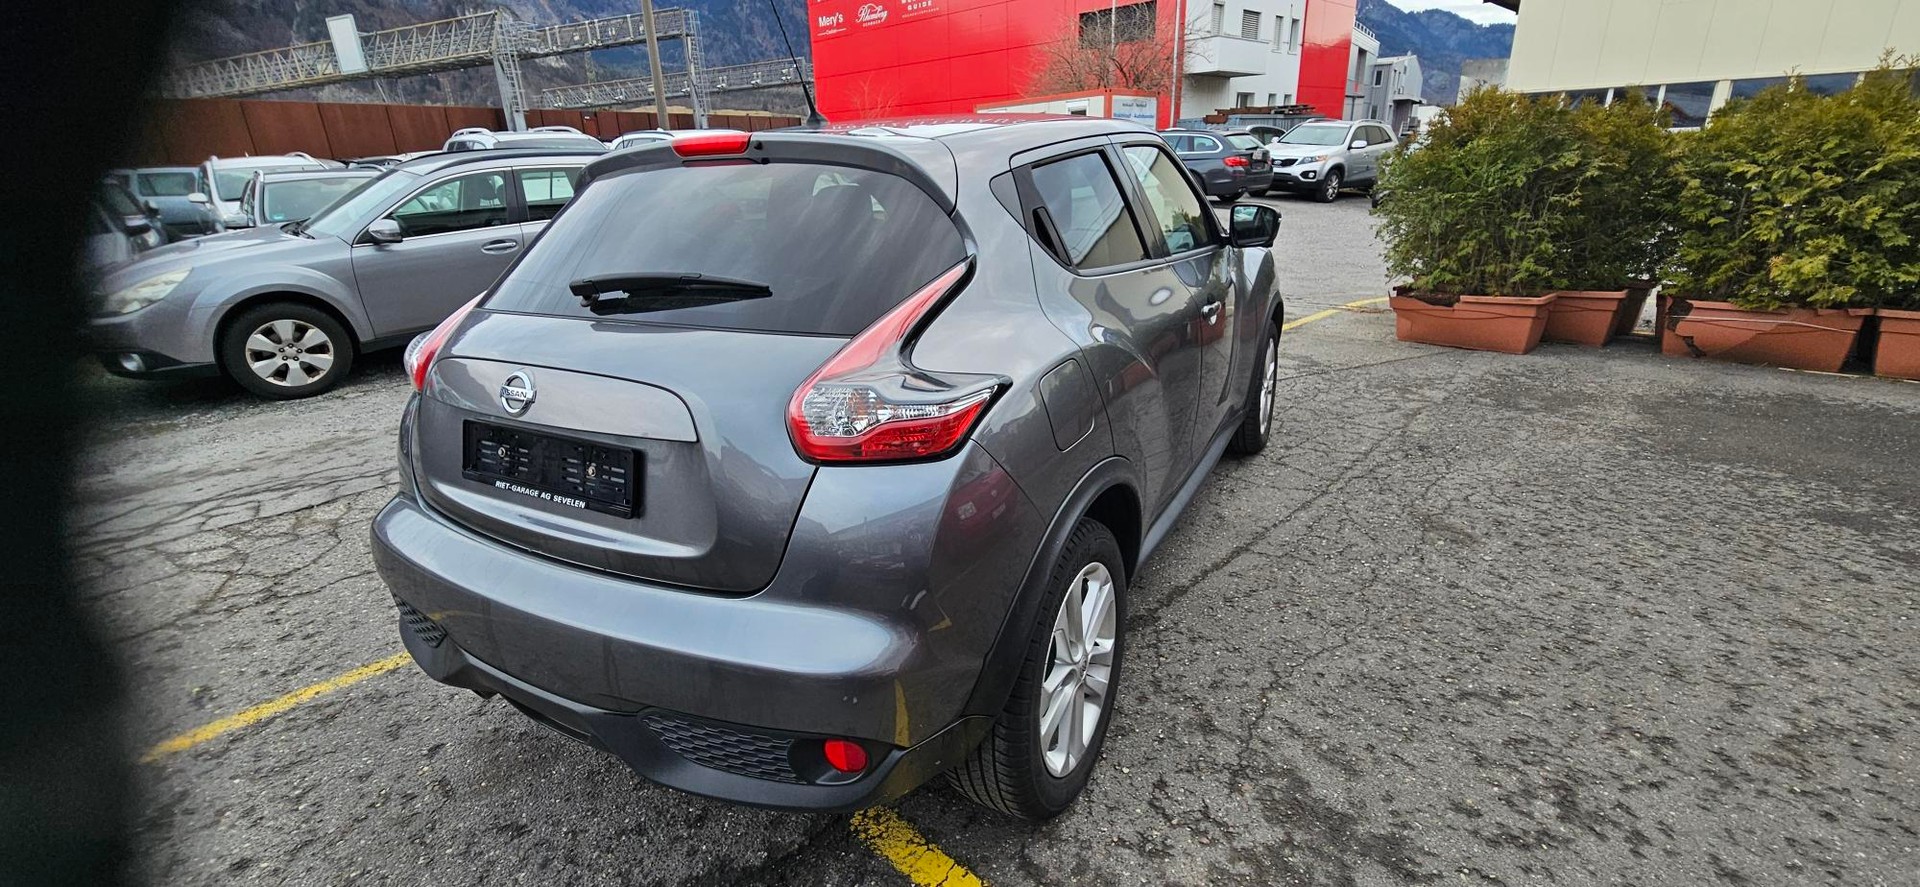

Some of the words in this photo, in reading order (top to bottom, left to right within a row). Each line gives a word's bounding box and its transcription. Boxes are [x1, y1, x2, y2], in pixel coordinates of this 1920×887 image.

[495, 480, 540, 498] RIET-GARAGE
[540, 491, 551, 500] AG
[553, 494, 586, 509] SEVELEN
